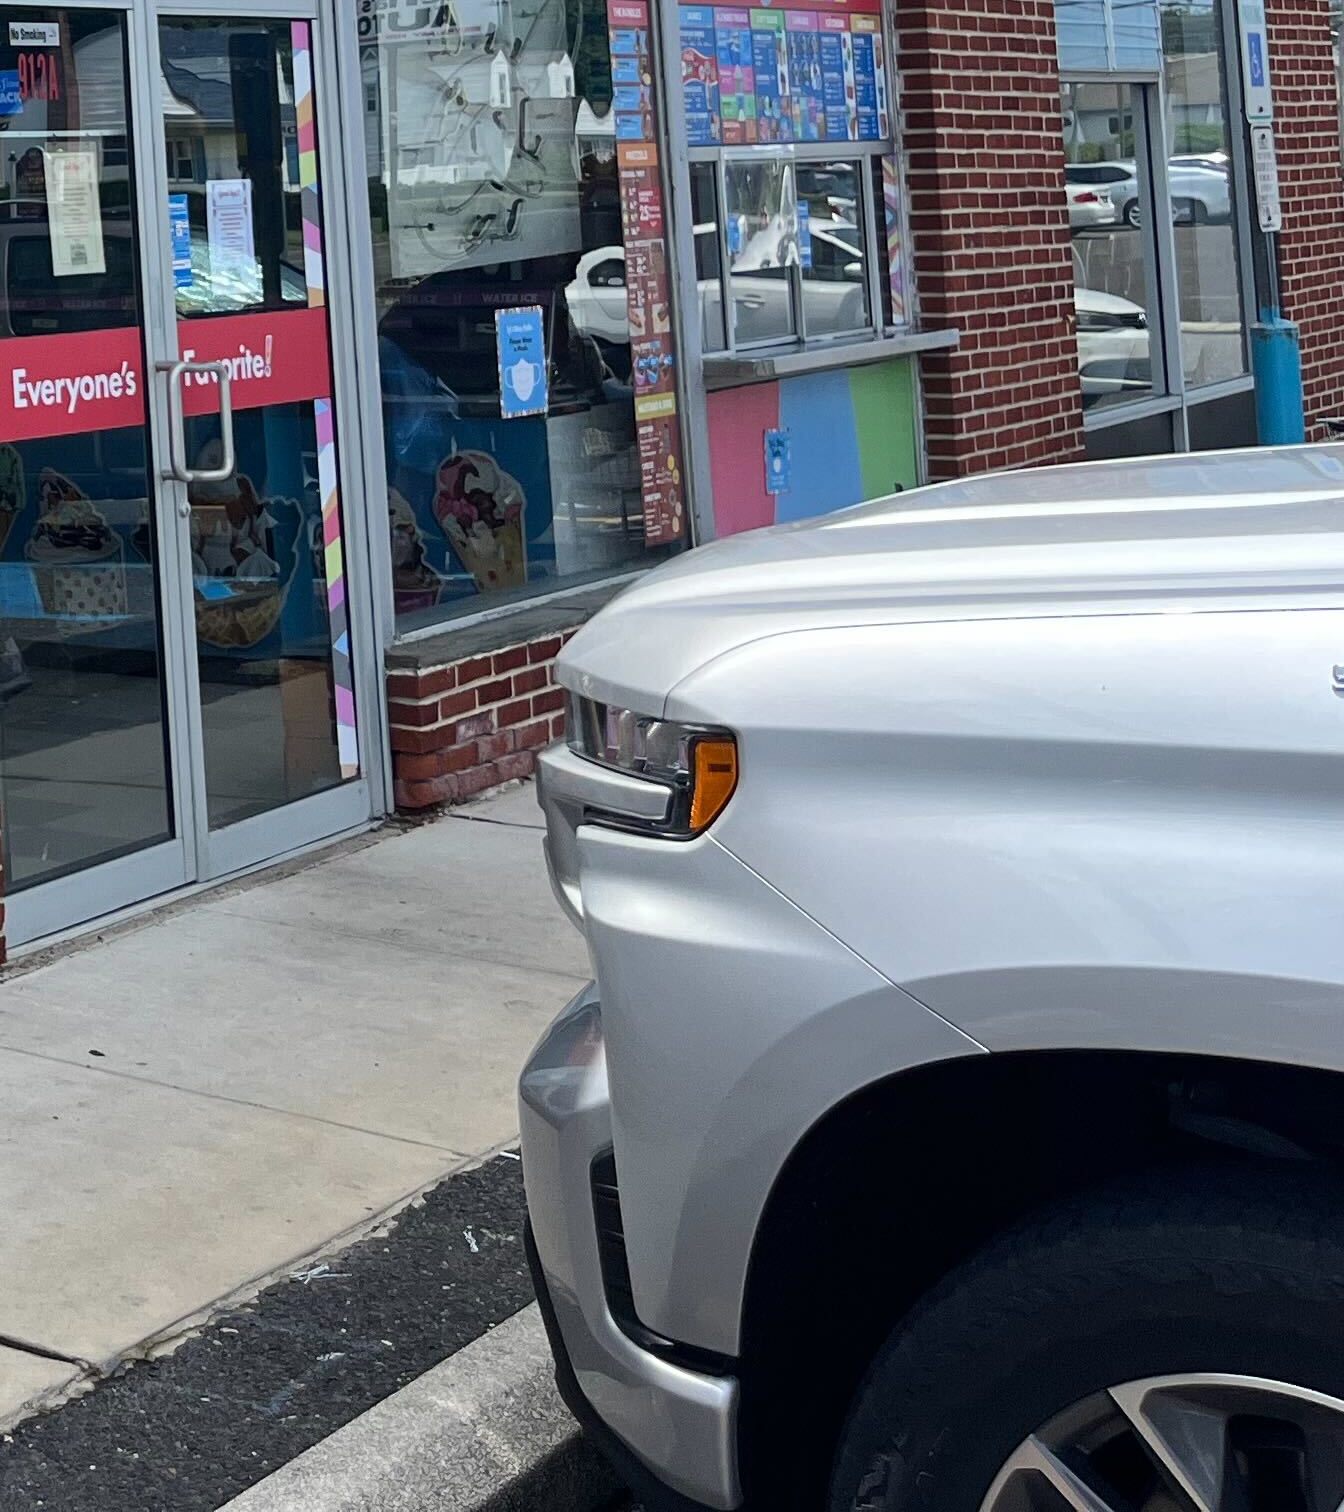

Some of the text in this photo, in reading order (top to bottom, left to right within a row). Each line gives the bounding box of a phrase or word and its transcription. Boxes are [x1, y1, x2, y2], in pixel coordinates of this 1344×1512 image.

[10, 28, 47, 43] No Smoking
[12, 360, 136, 414] Everyone's
